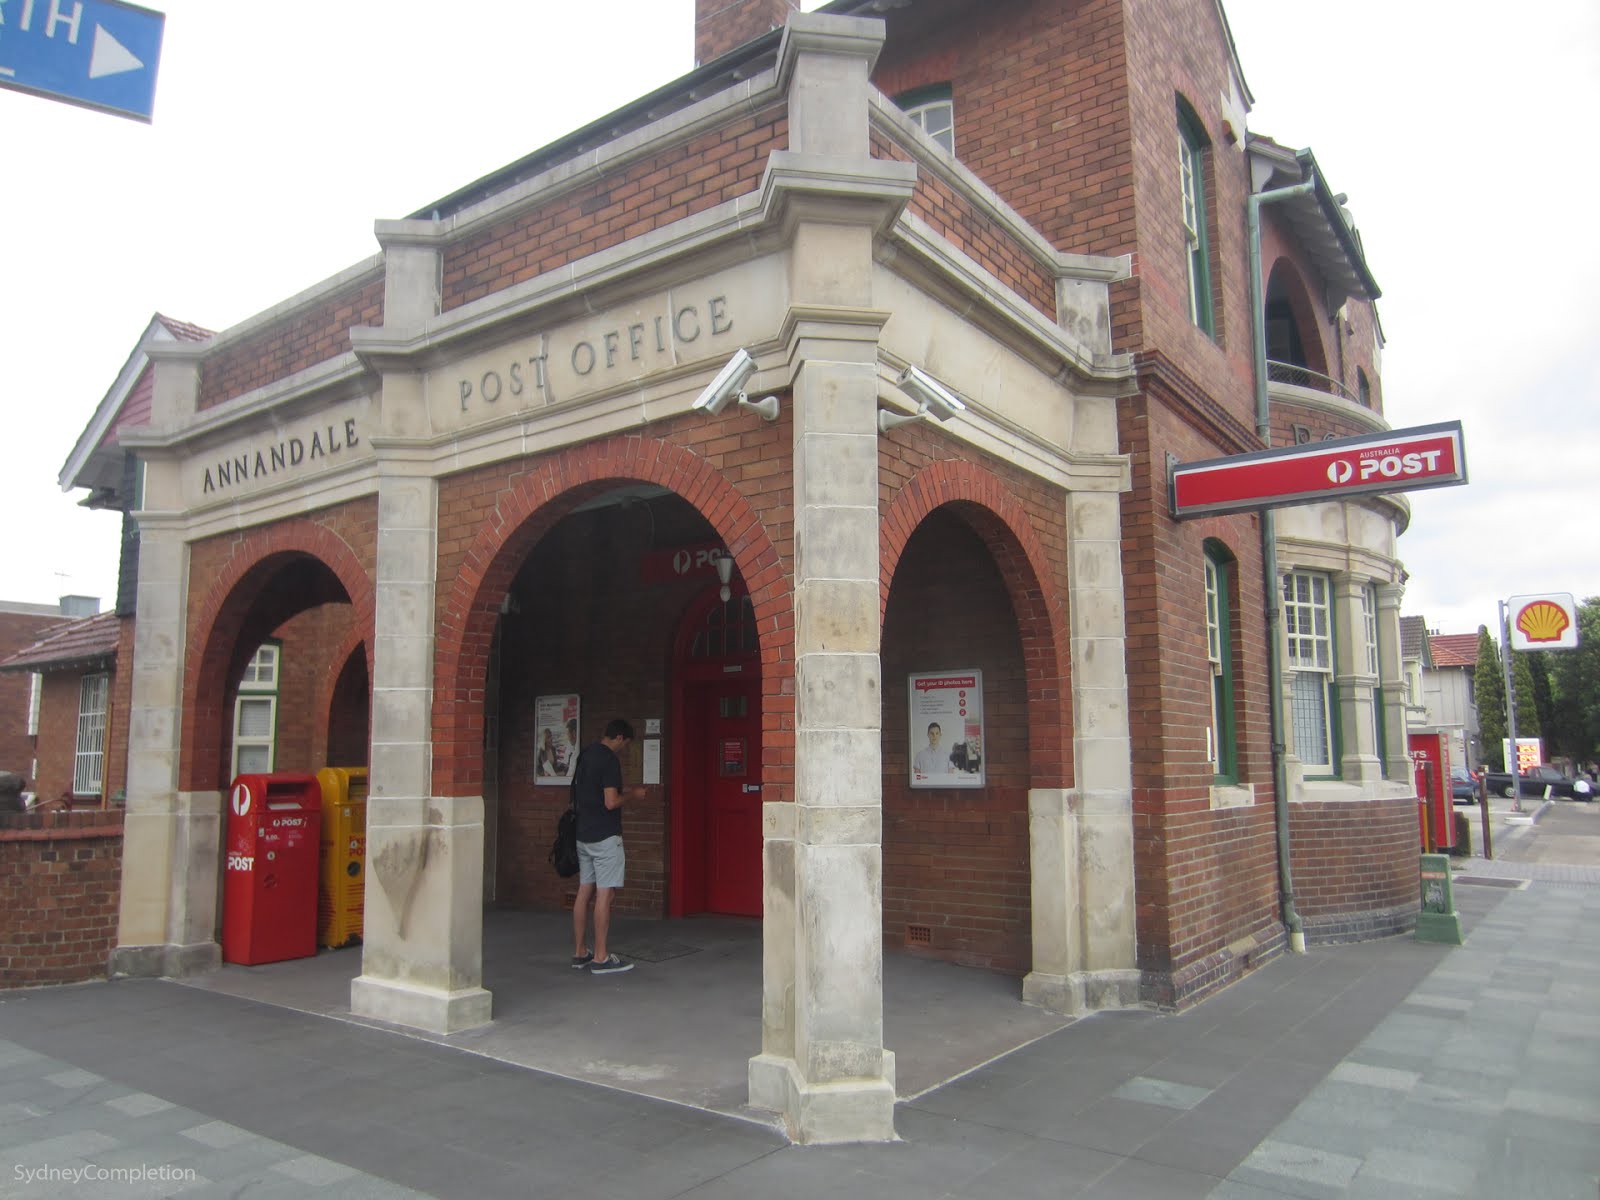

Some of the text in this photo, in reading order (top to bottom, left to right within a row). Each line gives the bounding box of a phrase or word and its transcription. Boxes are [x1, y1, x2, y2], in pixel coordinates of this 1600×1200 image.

[458, 295, 733, 411] POST OFFICE
[203, 418, 359, 494] ANNANDALE
[1360, 448, 1400, 458] AUSTRALIA
[1360, 450, 1440, 480] POST
[281, 819, 303, 827] POST
[228, 856, 254, 871] POST
